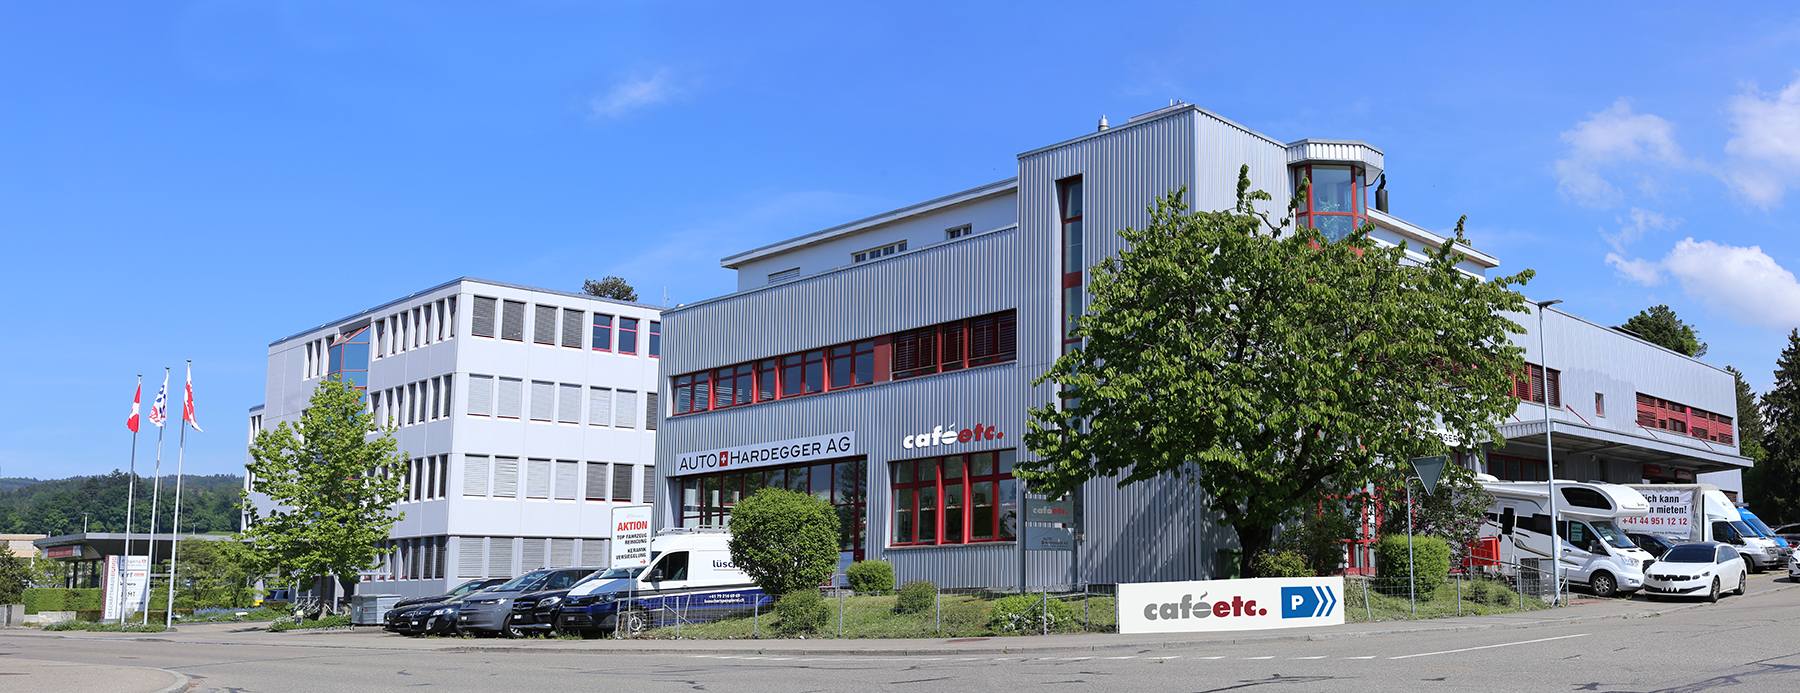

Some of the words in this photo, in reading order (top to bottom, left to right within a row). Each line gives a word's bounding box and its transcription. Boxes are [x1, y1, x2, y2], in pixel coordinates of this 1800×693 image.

[679, 453, 717, 471] AUTO
[730, 442, 821, 465] HARDEGGER
[826, 436, 851, 453] AG
[1660, 494, 1680, 502] kann
[1656, 505, 1687, 514] mieten!
[1651, 517, 1664, 525] 951
[617, 521, 648, 532] AKTION
